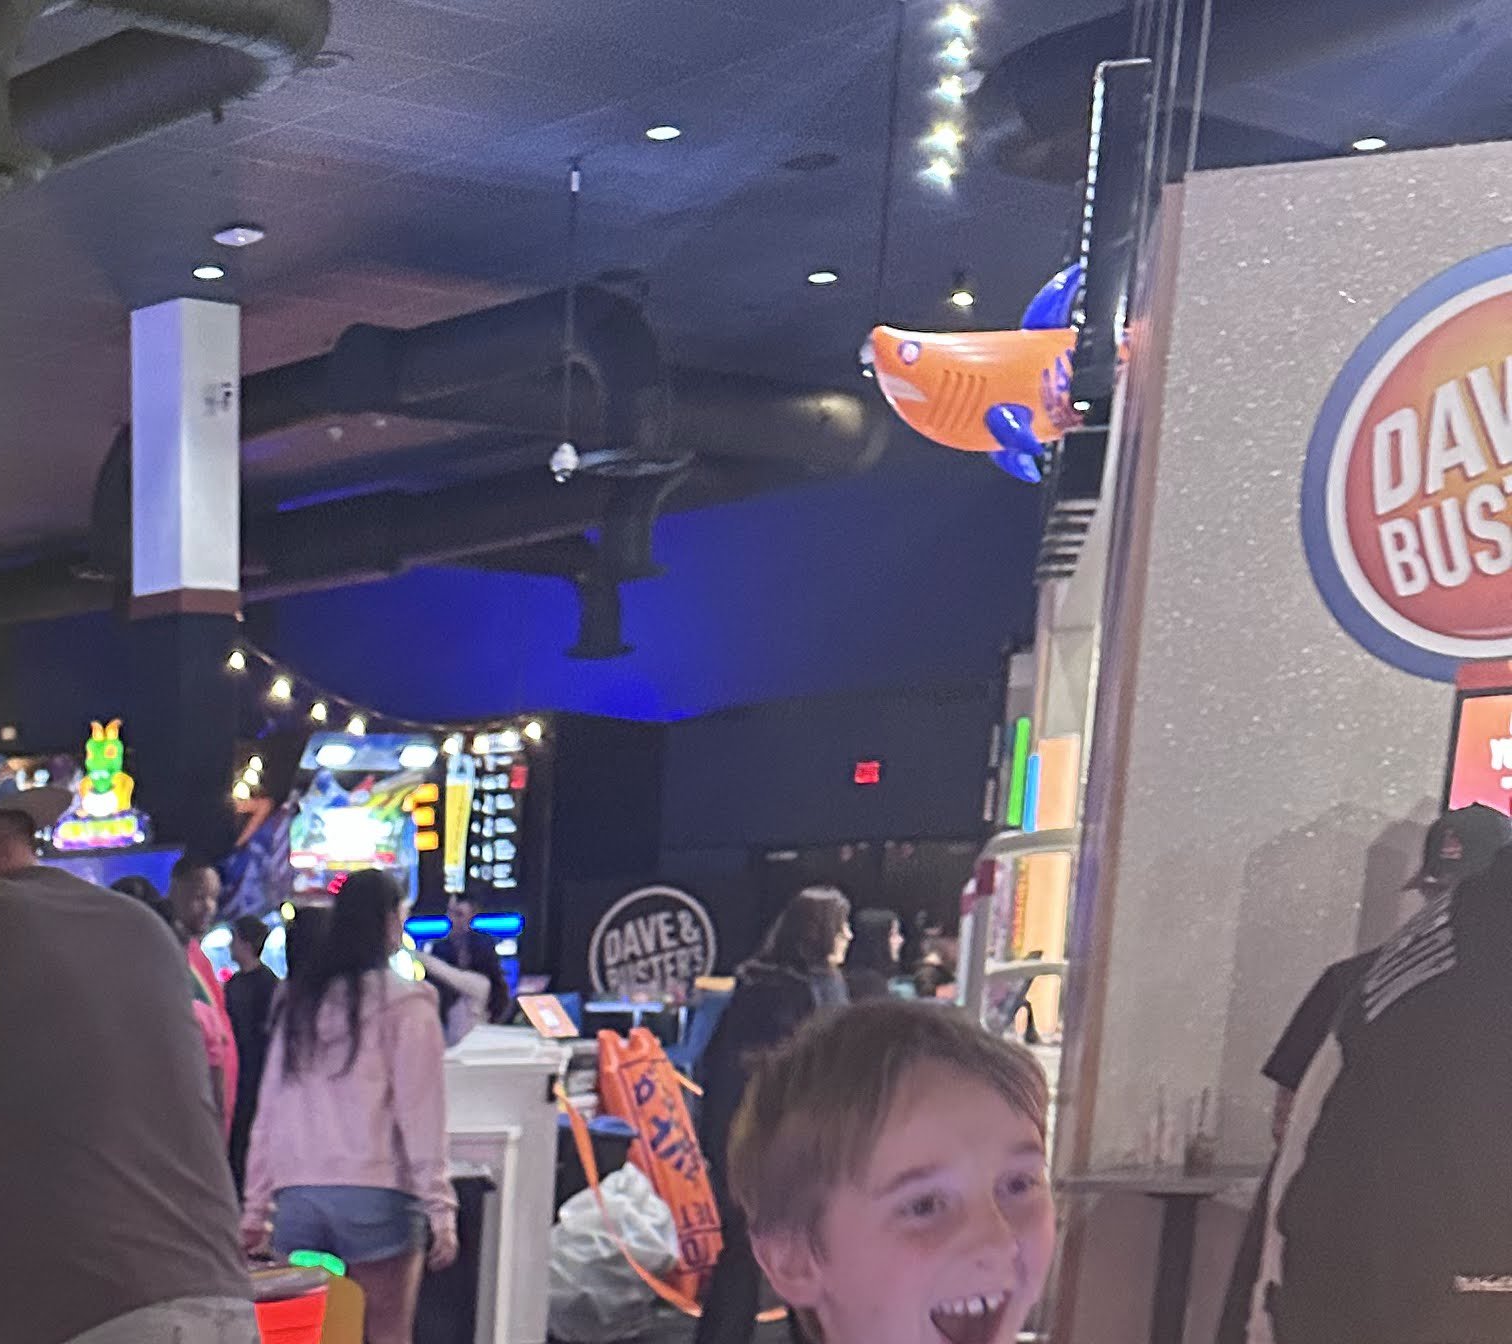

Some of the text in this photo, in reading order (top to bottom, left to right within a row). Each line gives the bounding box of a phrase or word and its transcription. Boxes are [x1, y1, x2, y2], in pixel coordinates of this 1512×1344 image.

[1379, 475, 1512, 597] BUS
[604, 909, 701, 967] DAVE &
